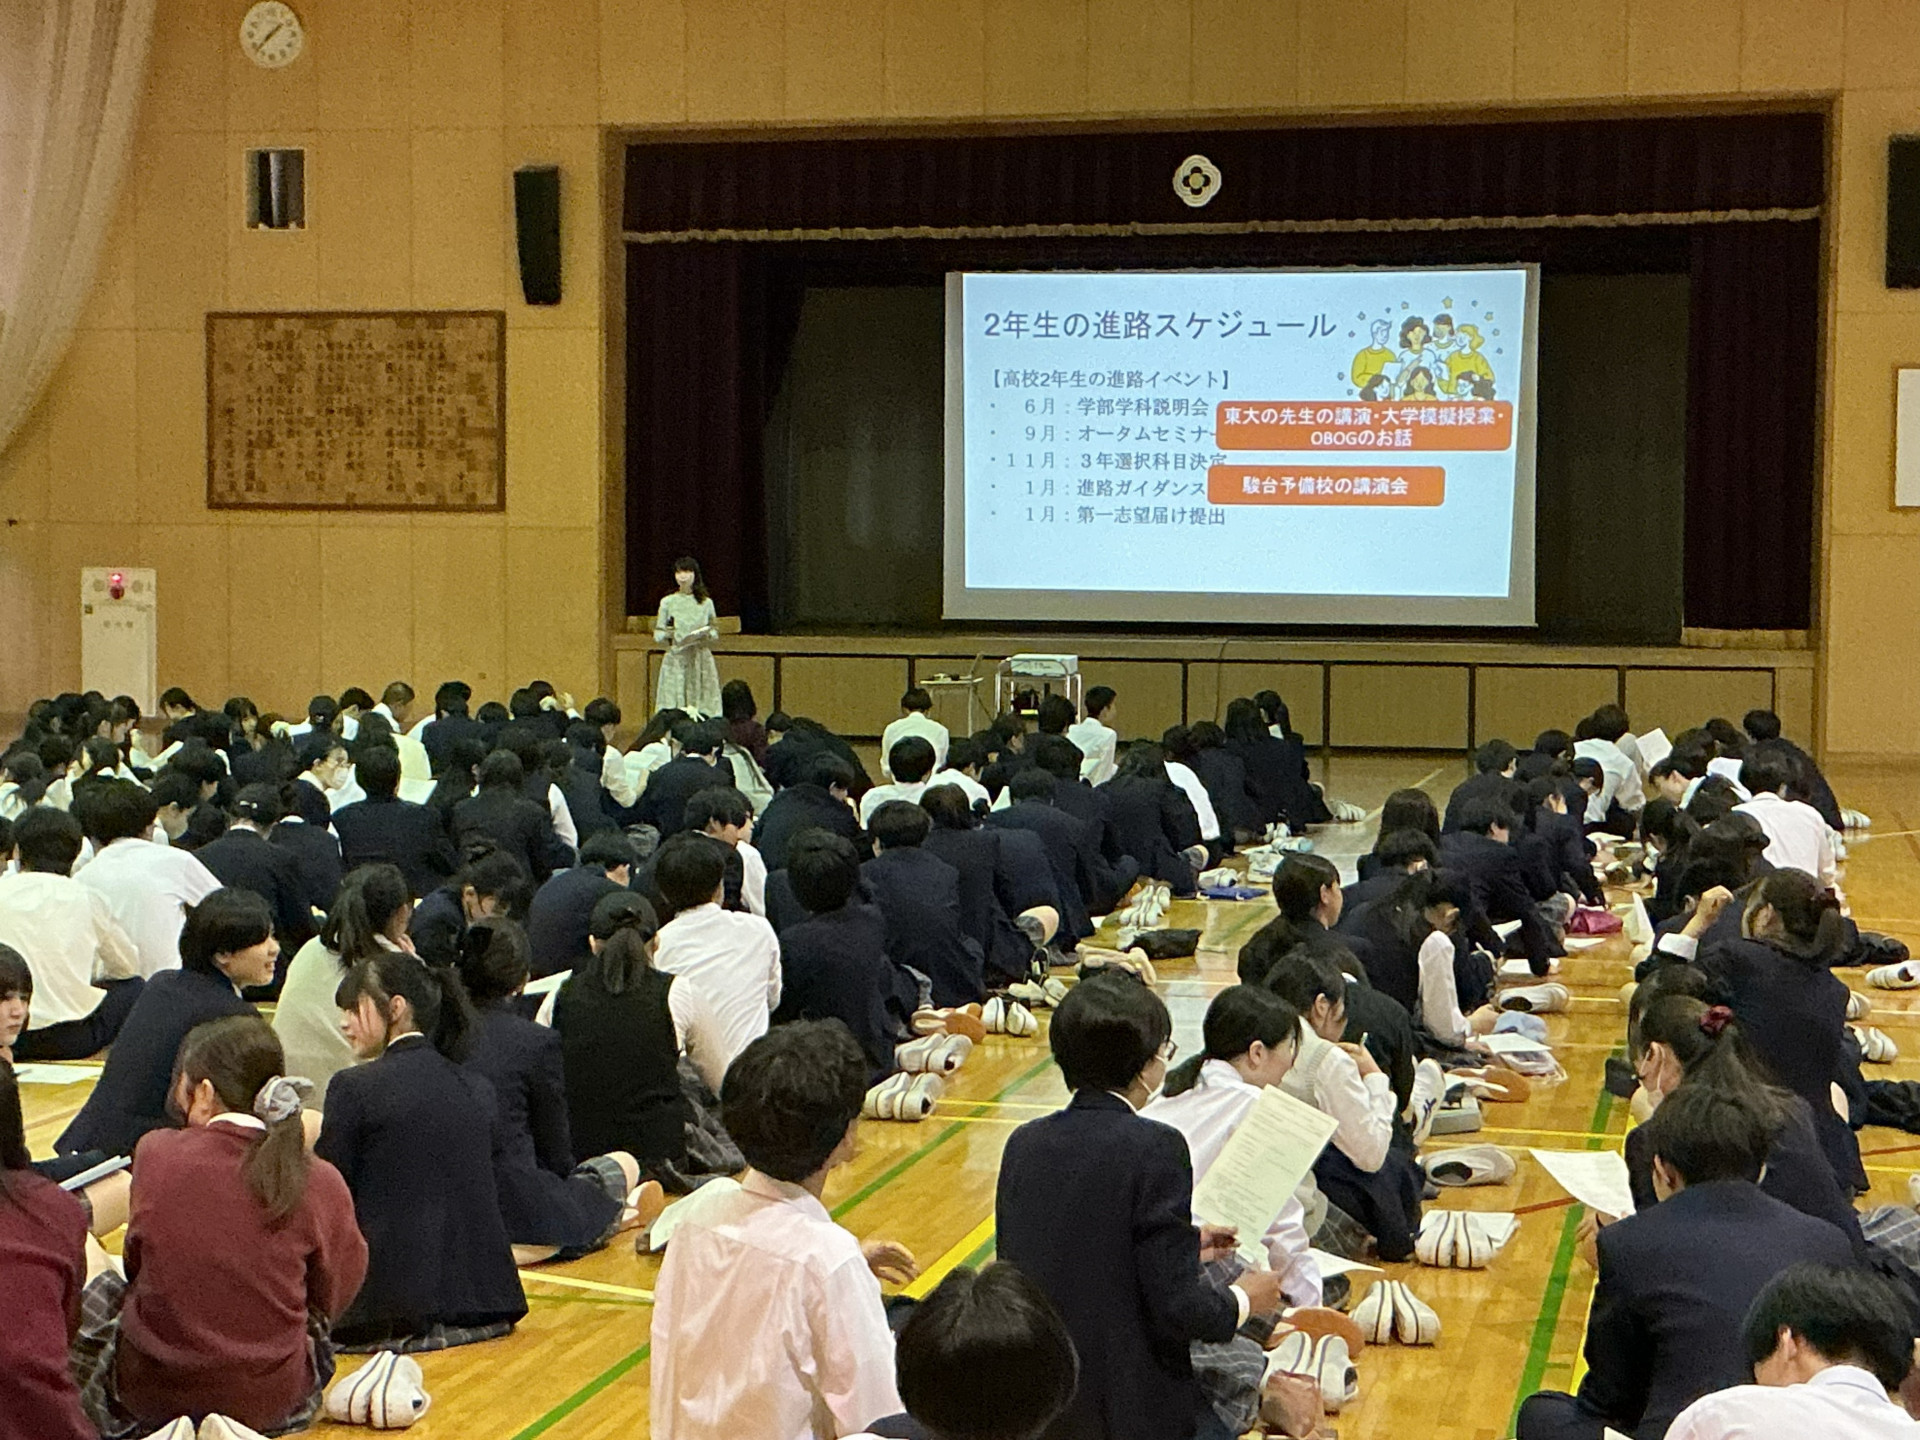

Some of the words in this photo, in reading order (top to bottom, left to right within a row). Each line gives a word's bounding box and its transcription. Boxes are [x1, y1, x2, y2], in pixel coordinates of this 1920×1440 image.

[984, 310, 1336, 340] 2年生の進路スケジュール
[1311, 429, 1413, 447] OBOGのお話
[1242, 476, 1408, 495] 駿台予備校の講演会
